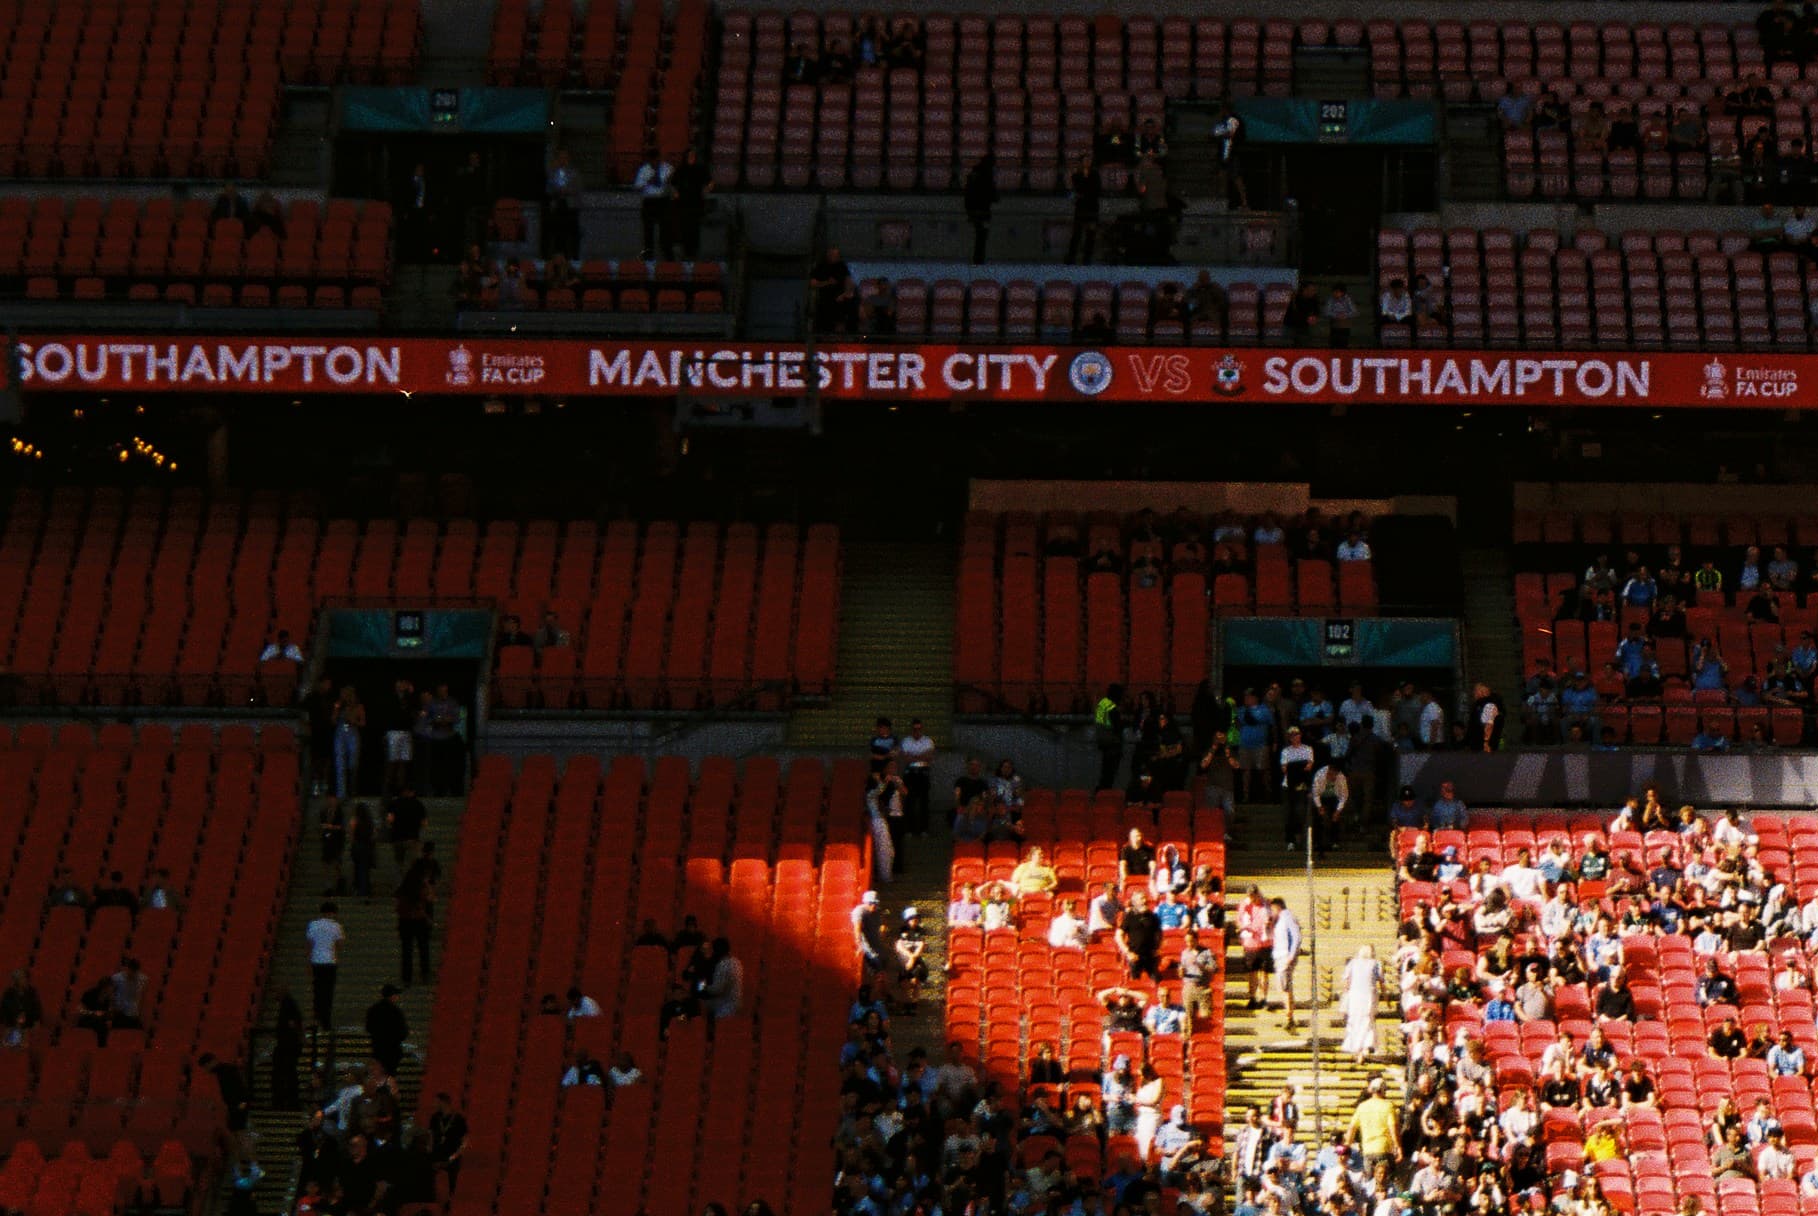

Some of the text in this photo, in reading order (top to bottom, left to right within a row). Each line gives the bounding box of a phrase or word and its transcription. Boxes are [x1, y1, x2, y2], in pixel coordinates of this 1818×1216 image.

[1322, 104, 1345, 119] 202
[17, 342, 401, 384] SOUTHAMPTON
[481, 352, 545, 368] Emirates
[481, 367, 546, 384] FA CUP
[589, 349, 1650, 398] MANCHESTER CITY VS SOUTHAMPTON
[1735, 366, 1798, 382] Emirates
[1735, 381, 1799, 398] FA CUP
[1328, 624, 1351, 640] 102
